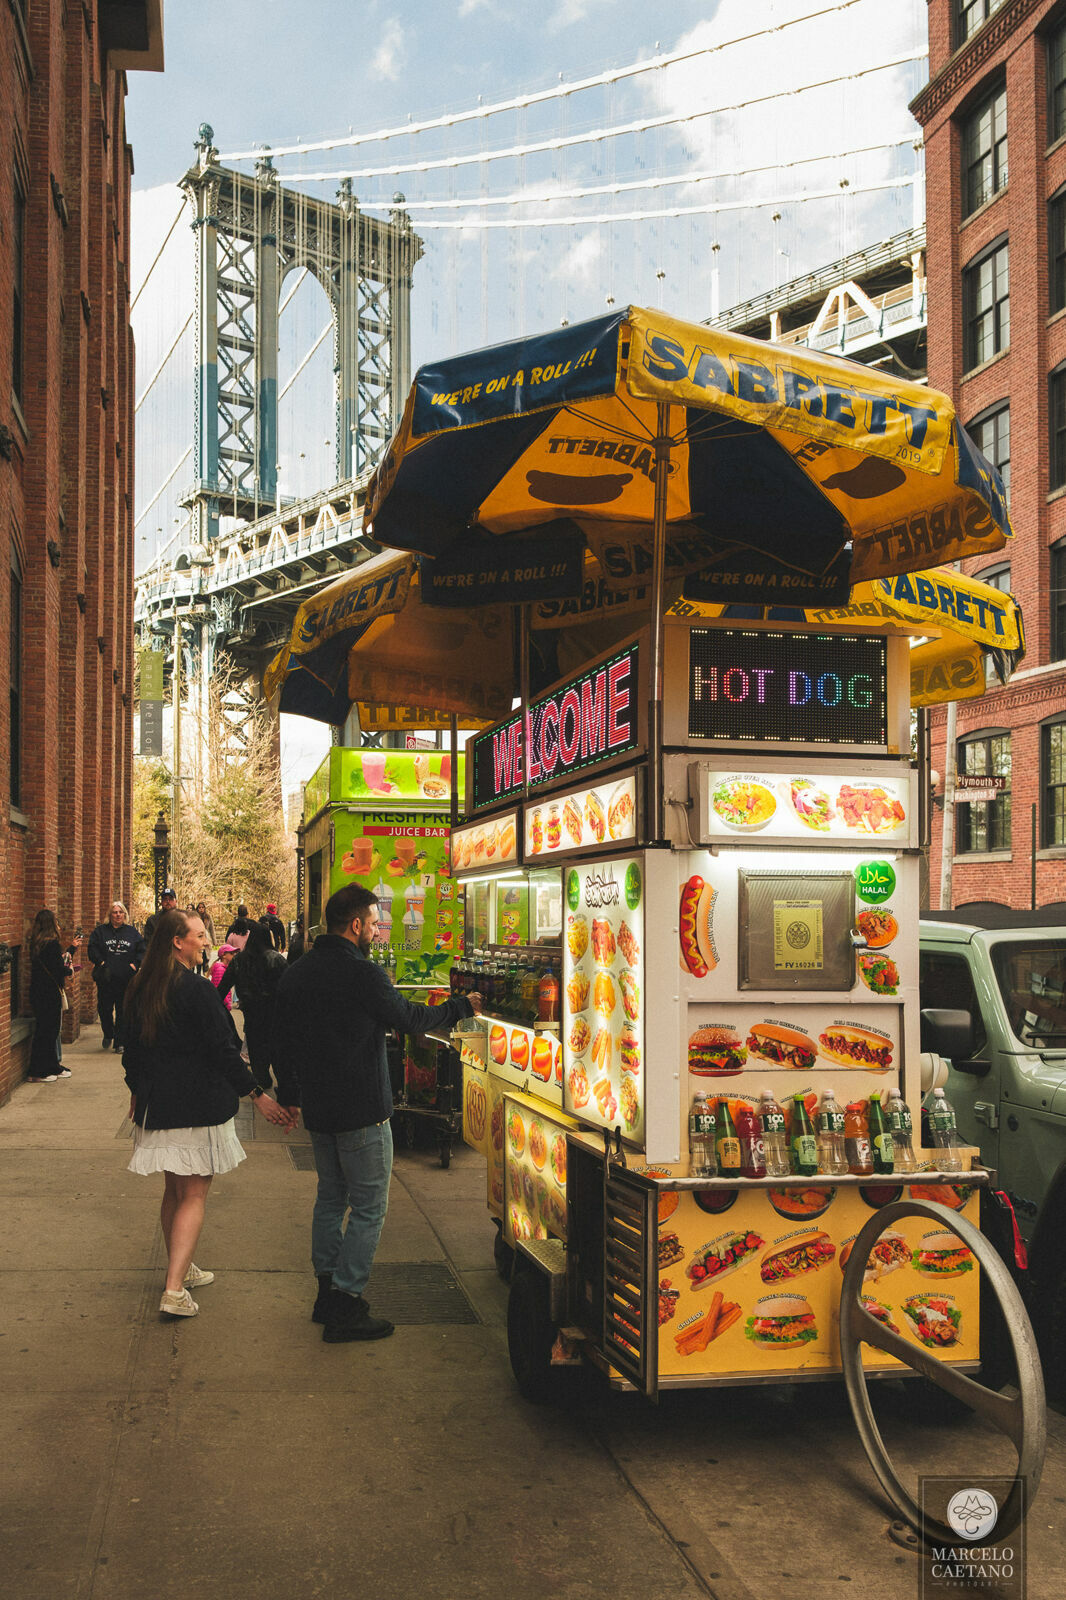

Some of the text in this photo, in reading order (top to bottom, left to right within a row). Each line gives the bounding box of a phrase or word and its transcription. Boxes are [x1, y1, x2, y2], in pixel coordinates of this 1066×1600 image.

[431, 382, 483, 406] WE'RE
[486, 374, 511, 394] ON
[511, 369, 525, 387] A
[530, 360, 573, 385] ROLL
[642, 328, 938, 450] SABRETT
[895, 445, 921, 464] 2019
[432, 572, 474, 588] WE'RE
[499, 569, 511, 583] A
[513, 565, 546, 583] ROLL
[744, 573, 763, 586] ON
[765, 574, 777, 587] A
[781, 575, 815, 588] ROLL
[693, 666, 873, 708] HOT DOG
[145, 703, 154, 753] Mellon
[493, 656, 630, 794] WELCOME
[957, 776, 1003, 788] Plymouth St
[362, 812, 417, 823] FRESH
[389, 827, 446, 837] JUICE BAR
[424, 875, 431, 886] 7
[862, 886, 888, 894] HALAL
[699, 1114, 716, 1125] 100
[766, 1114, 784, 1124] 100
[676, 1309, 705, 1331] CHURROS
